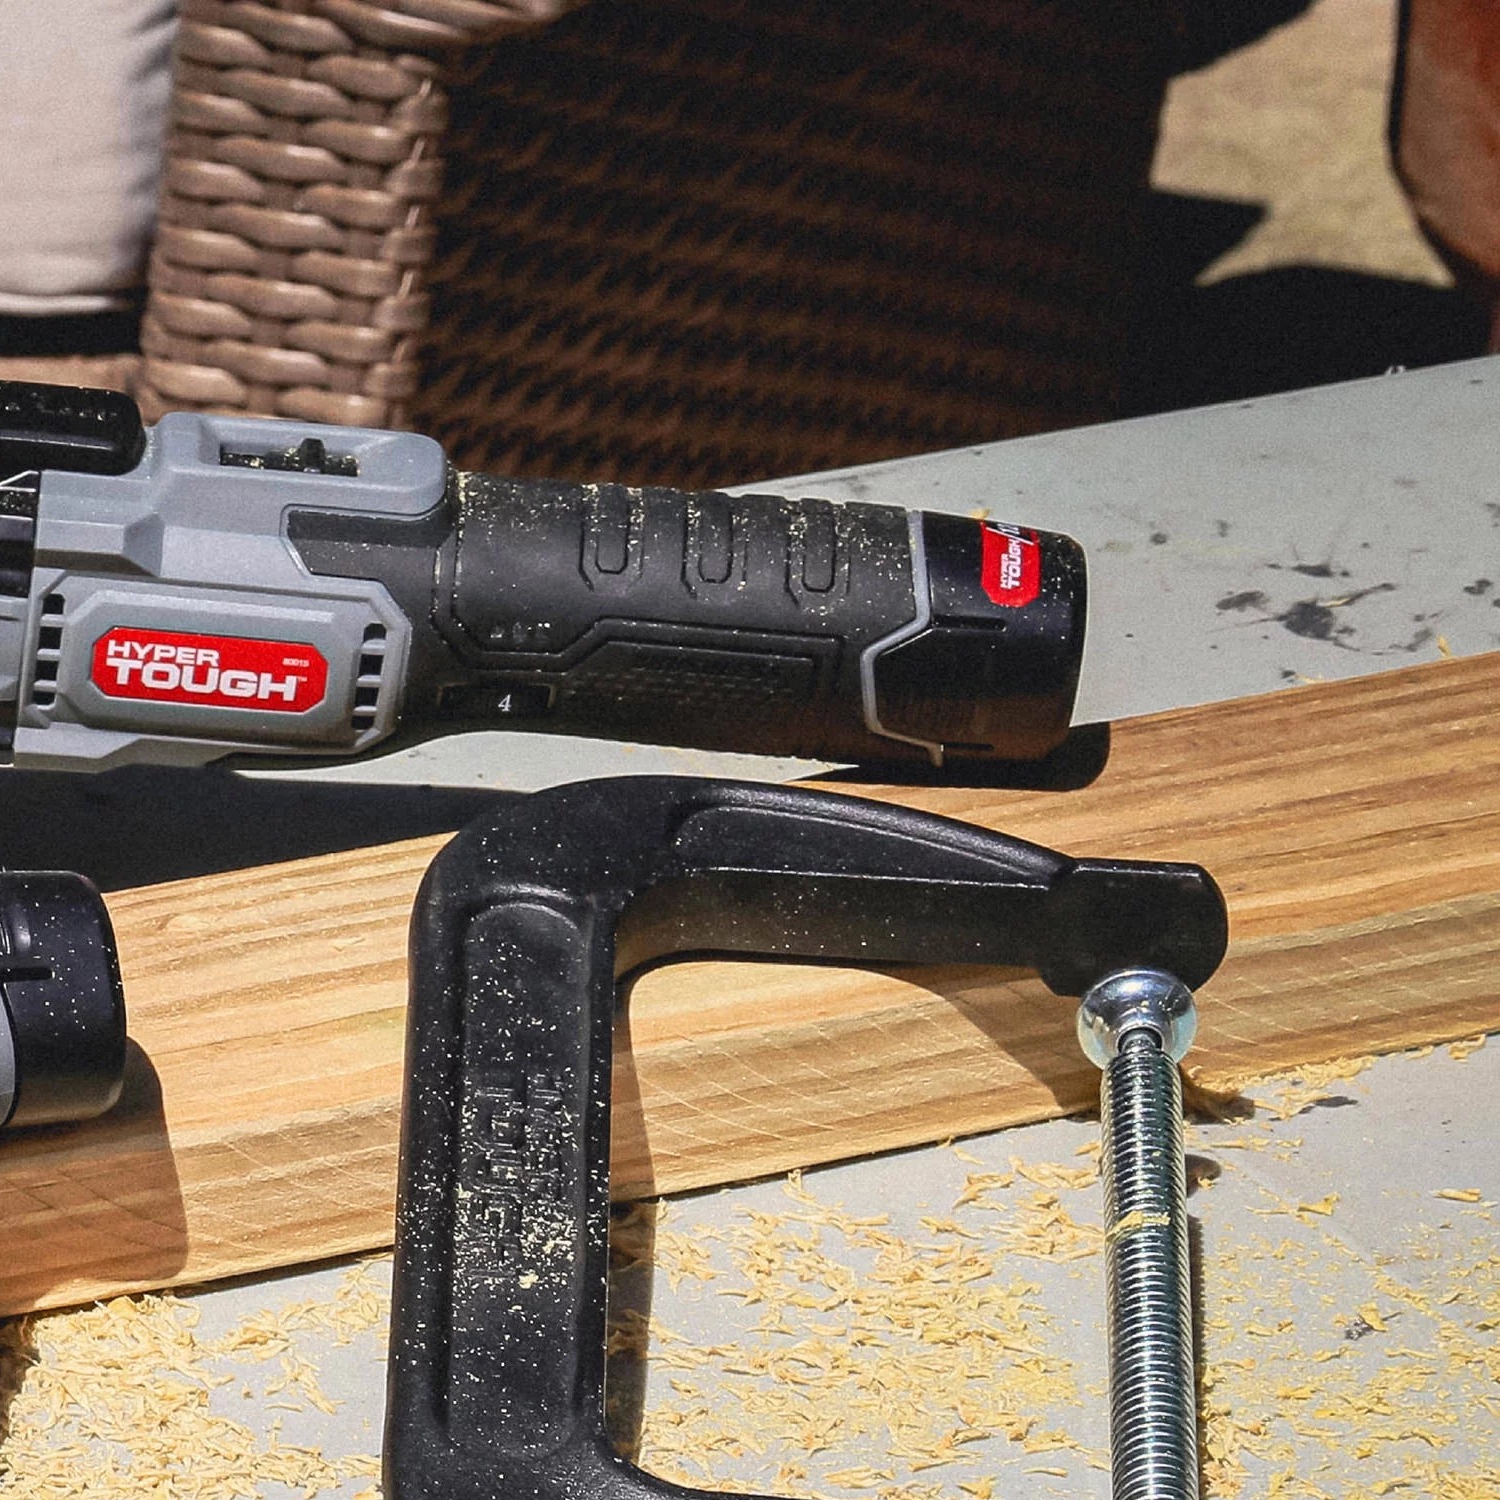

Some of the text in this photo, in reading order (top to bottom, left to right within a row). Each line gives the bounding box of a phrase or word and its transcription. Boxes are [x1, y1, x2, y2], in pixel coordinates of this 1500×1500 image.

[107, 639, 220, 667] HYPER
[106, 657, 298, 702] TOUGH
[497, 694, 513, 712] 4
